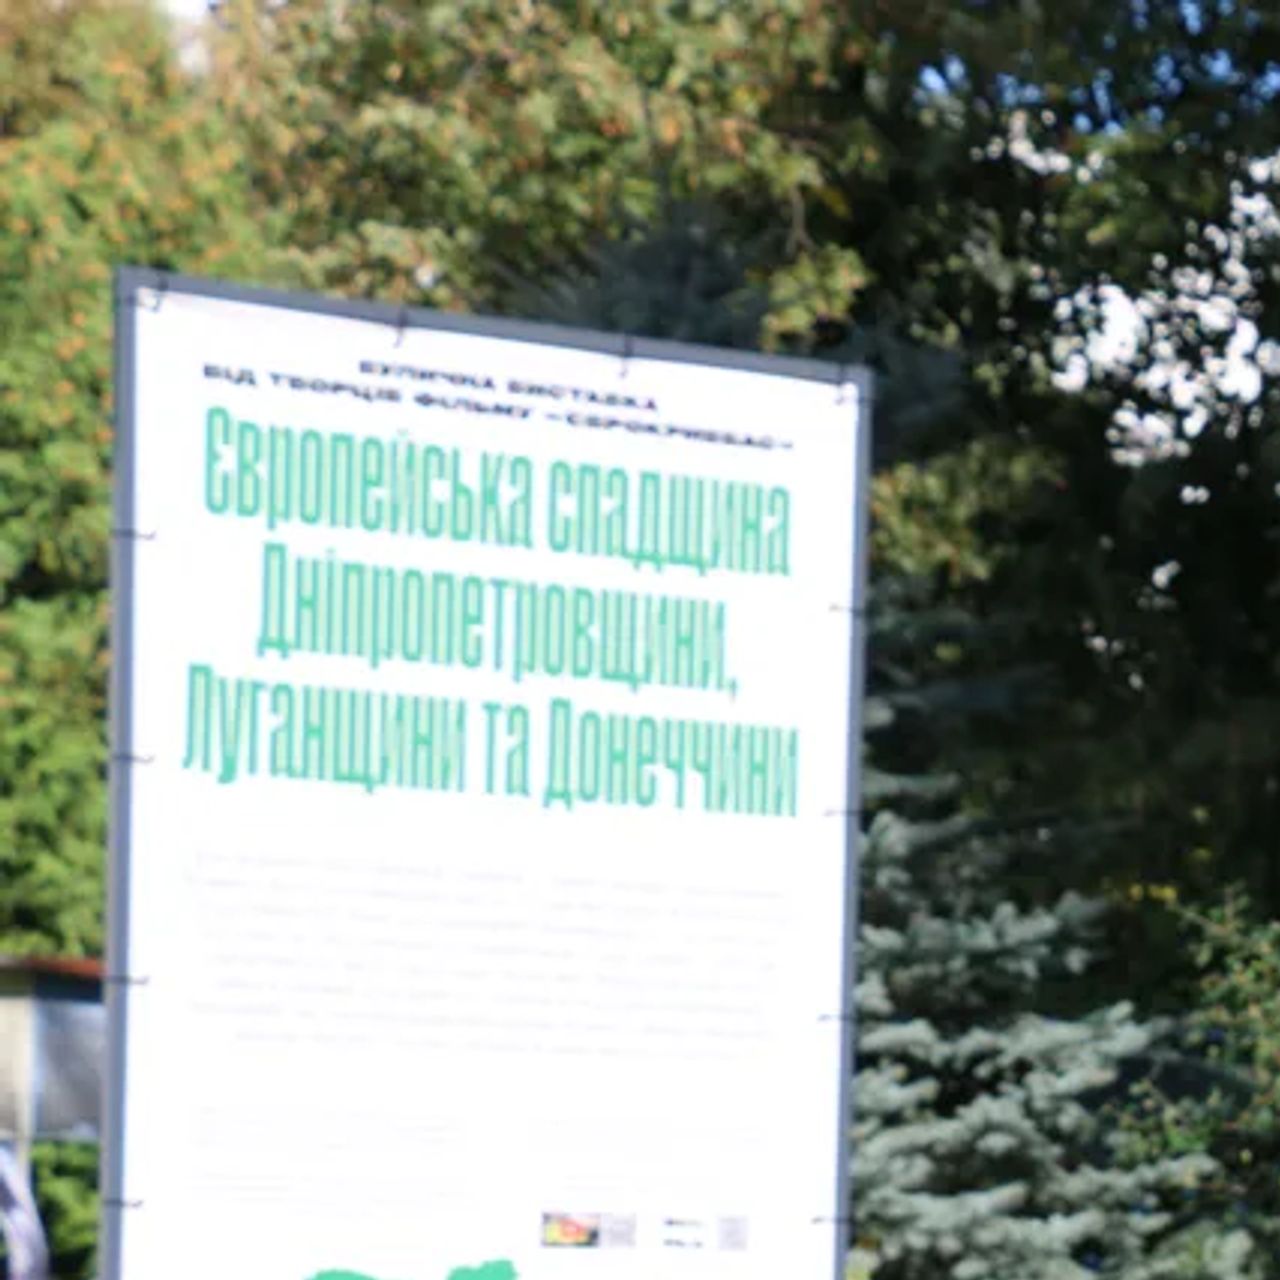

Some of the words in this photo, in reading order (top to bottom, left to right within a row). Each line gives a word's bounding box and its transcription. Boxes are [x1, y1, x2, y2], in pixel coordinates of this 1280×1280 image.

[202, 364, 257, 387] ВІД
[507, 379, 658, 412] ВИСТАВКА
[204, 406, 534, 548] Європейська
[547, 459, 790, 576] спадщина
[256, 541, 738, 692] Дніпропетровщини,
[182, 663, 467, 793] Луганщини
[482, 701, 530, 796] та
[542, 697, 798, 816] Донеччини
